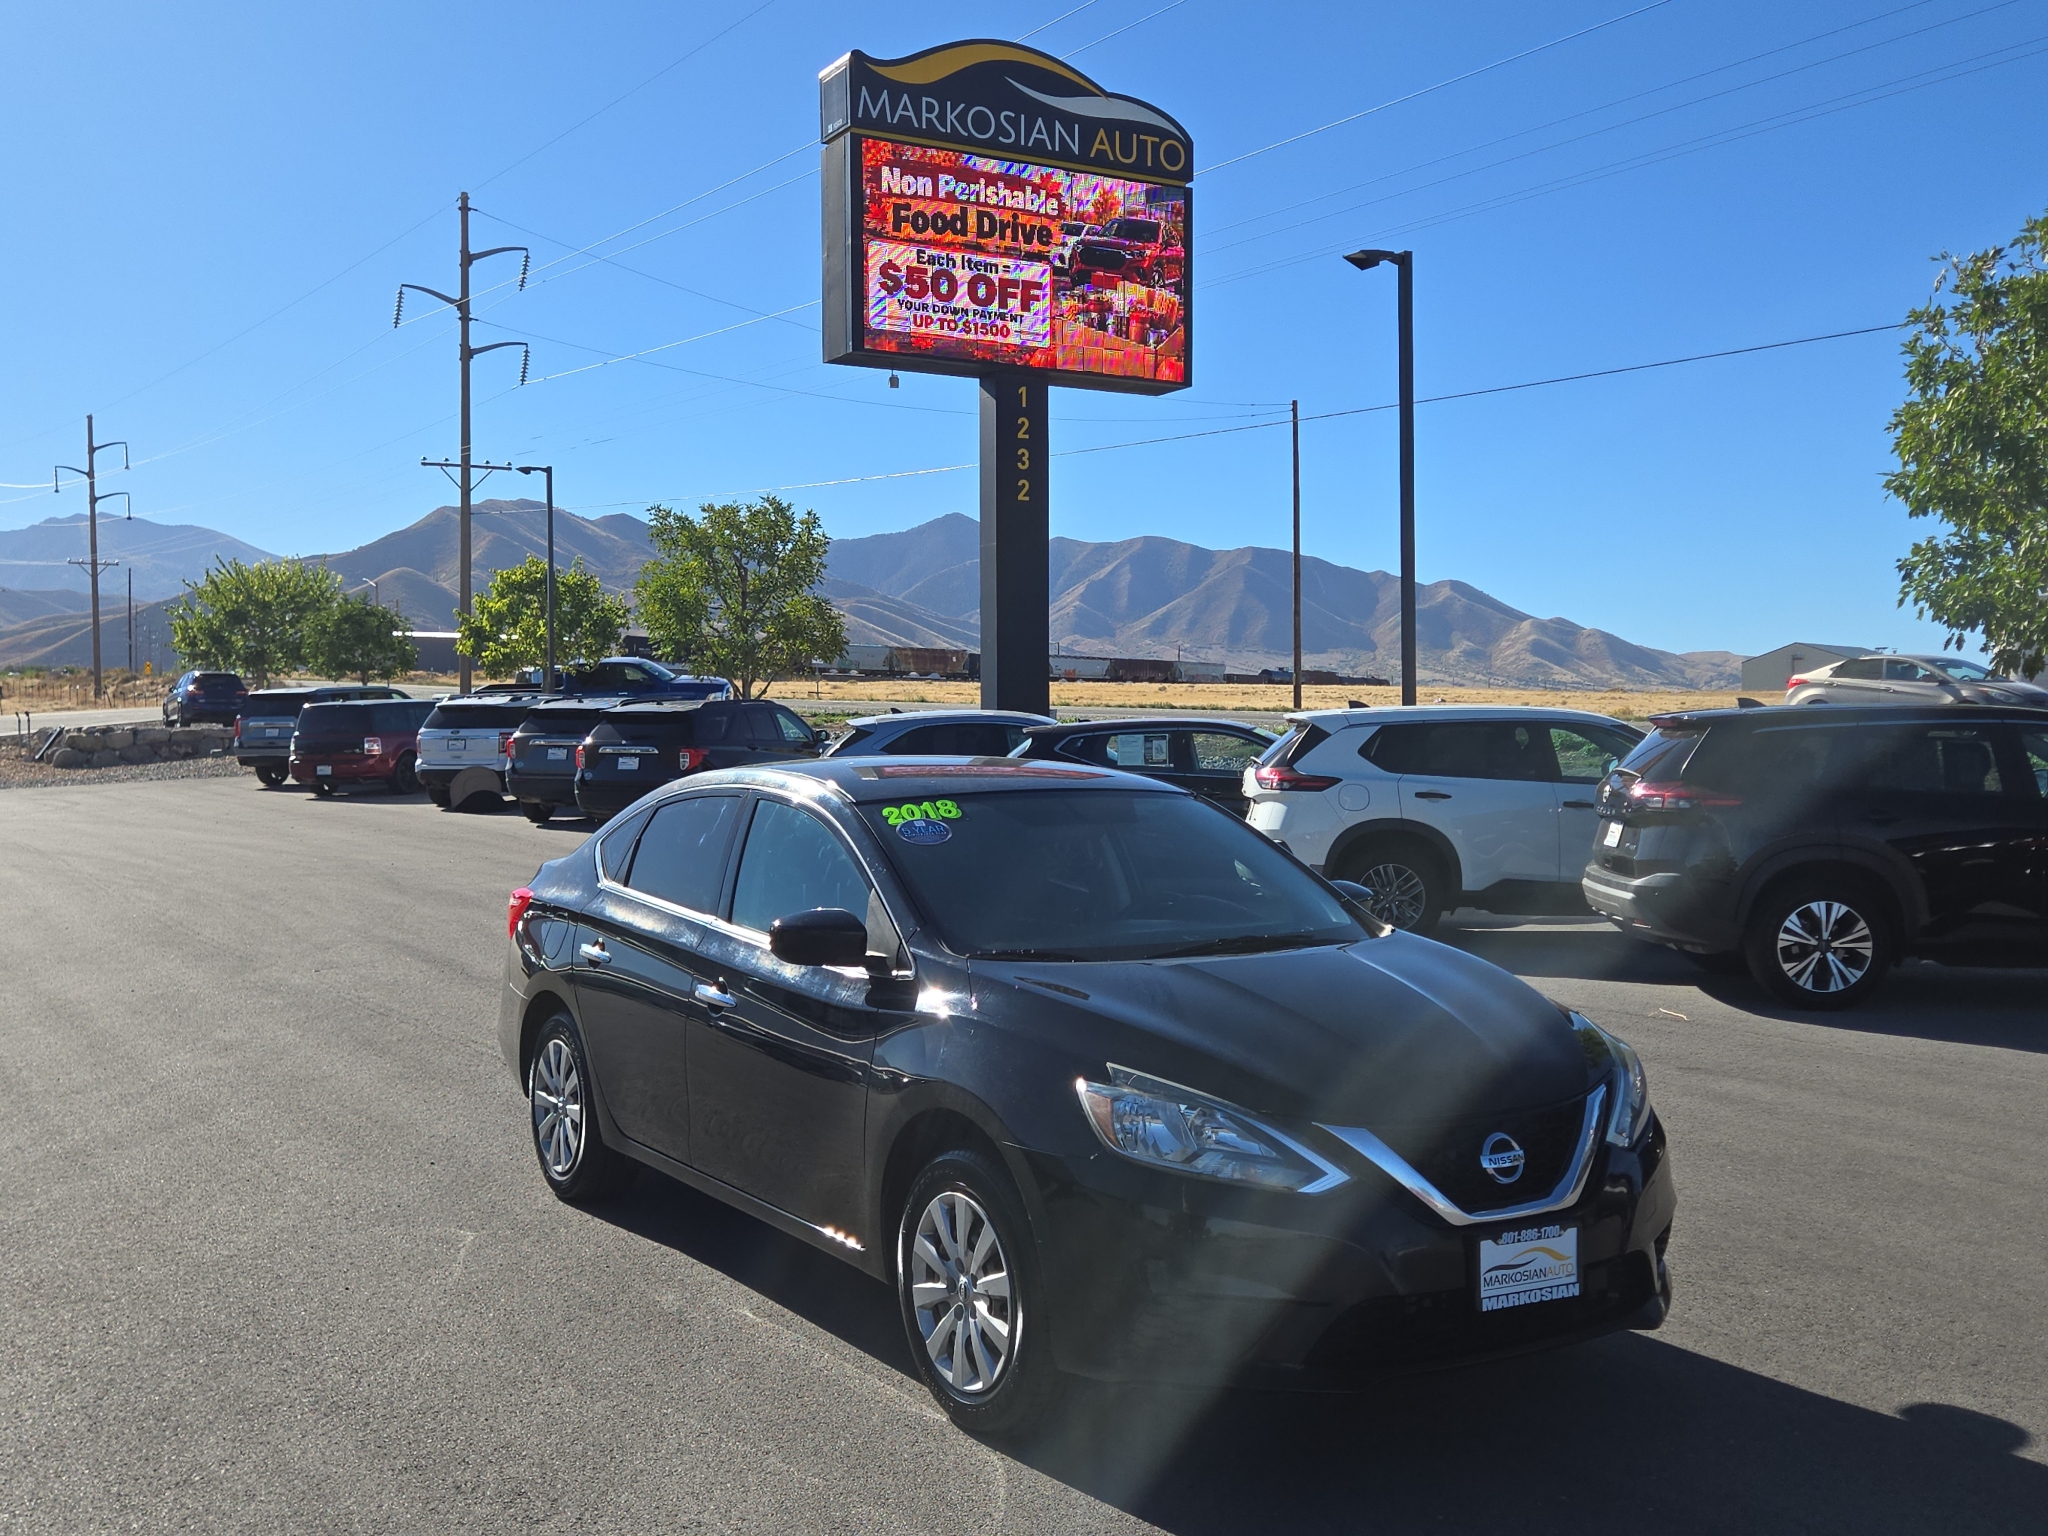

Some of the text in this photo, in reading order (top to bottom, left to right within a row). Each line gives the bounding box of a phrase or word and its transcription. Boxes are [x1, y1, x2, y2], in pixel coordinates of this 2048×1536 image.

[857, 85, 1186, 171] MARKOSIAN AUTO
[881, 165, 1059, 216] Non Perishable
[891, 202, 1053, 246] Food Drive
[916, 249, 956, 269] Each
[961, 255, 999, 274] Item
[878, 259, 1043, 312] $50 OFF
[897, 299, 1025, 323] YOUR DOWN PAYMENT
[912, 314, 1011, 339] UP TO $1500
[882, 799, 962, 826] 2018
[1487, 1152, 1524, 1166] NISSAN
[1481, 1283, 1580, 1312] MARKOSIAN
